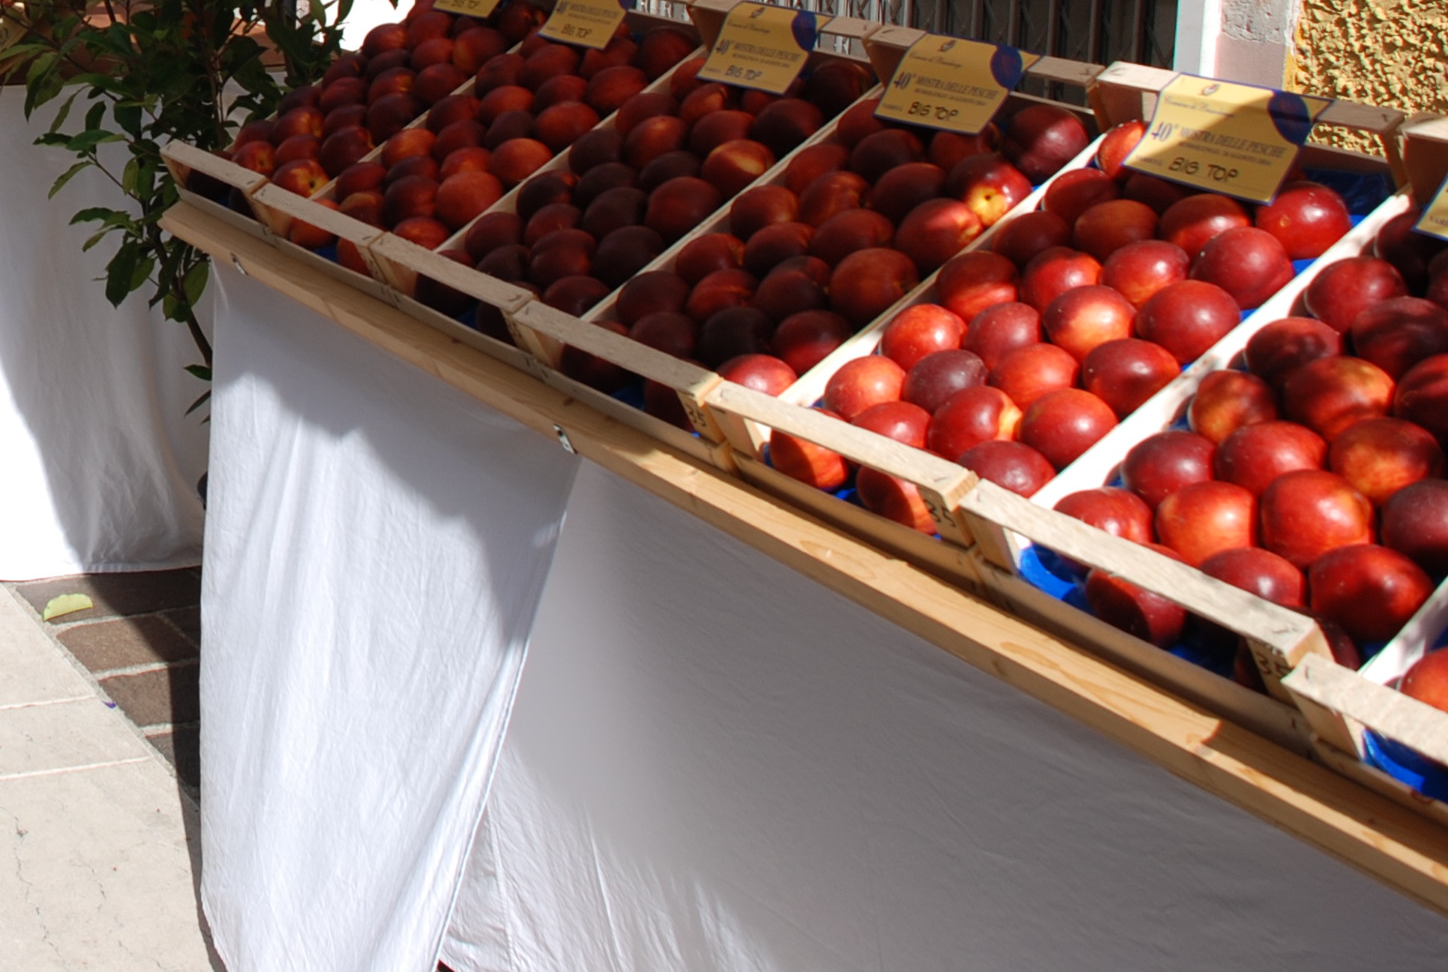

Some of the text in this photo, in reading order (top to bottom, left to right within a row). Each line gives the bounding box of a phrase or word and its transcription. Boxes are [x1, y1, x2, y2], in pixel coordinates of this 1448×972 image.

[744, 69, 762, 80] TOP
[908, 101, 930, 116] BIG
[935, 106, 959, 120] TOP
[1169, 157, 1199, 175] BIG
[1207, 164, 1239, 183] TOP
